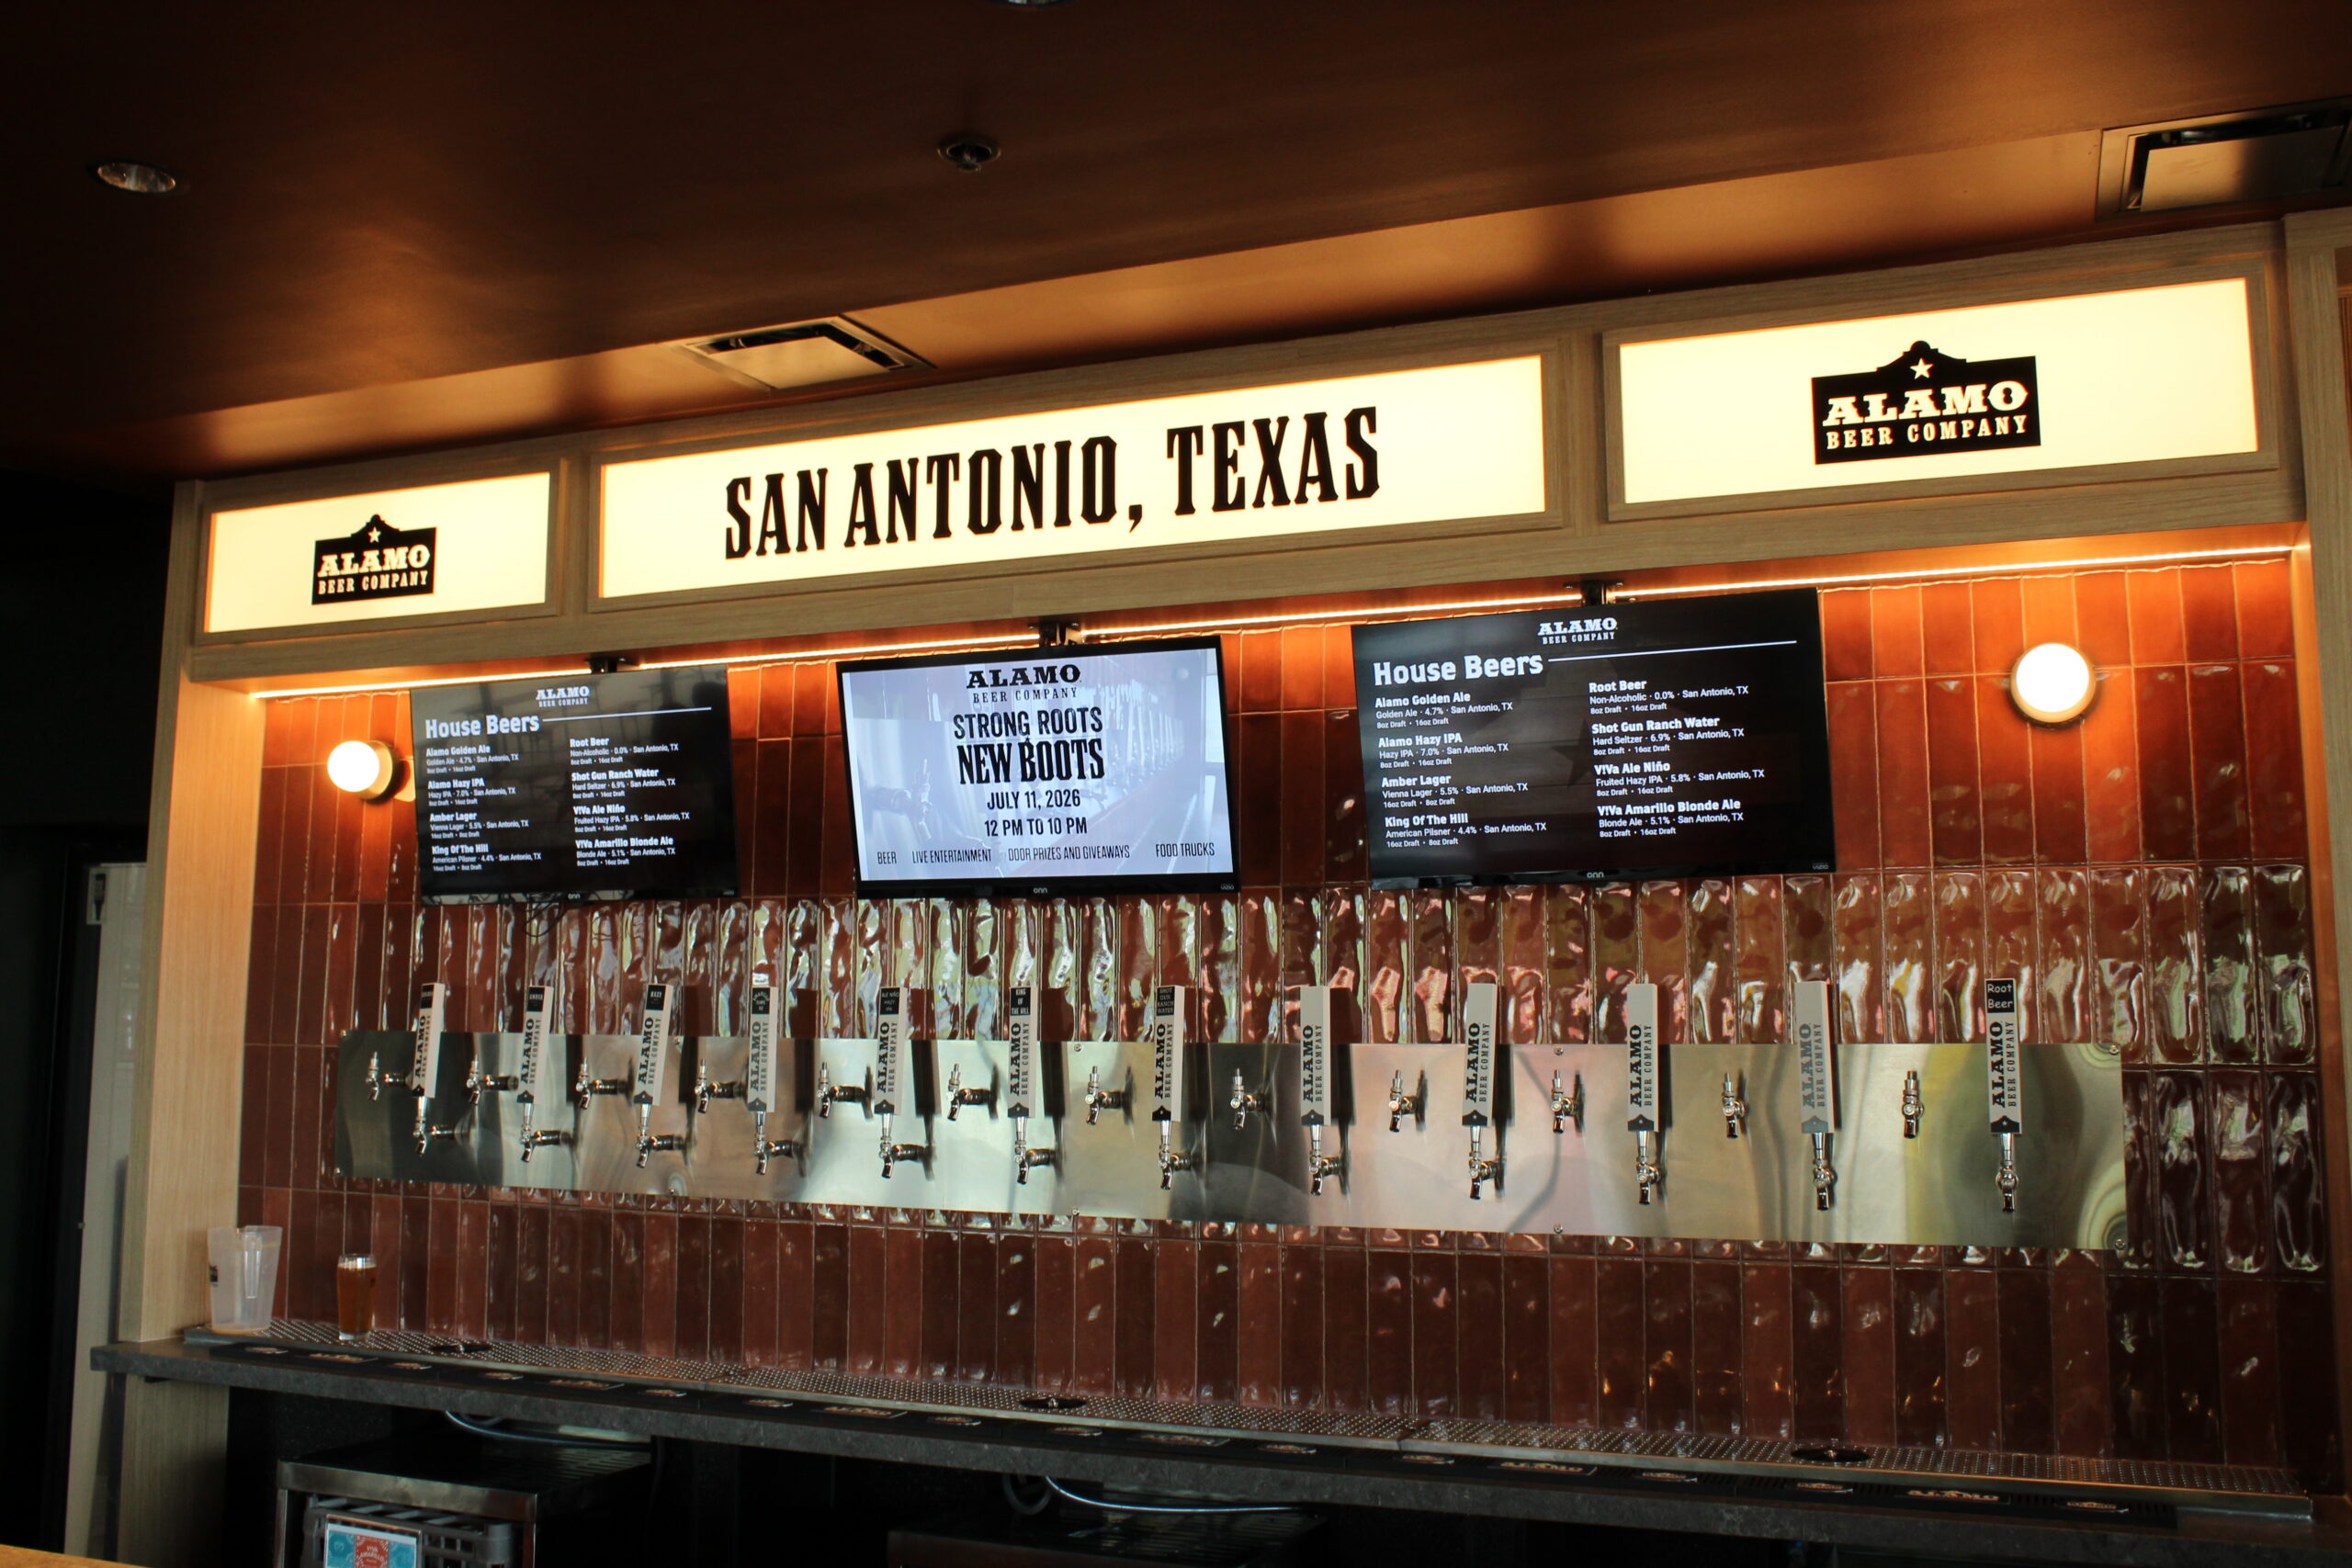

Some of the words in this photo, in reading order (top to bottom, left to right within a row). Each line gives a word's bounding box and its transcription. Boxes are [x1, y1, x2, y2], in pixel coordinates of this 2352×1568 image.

[1823, 380, 2029, 426] ALAMO
[1826, 427, 1893, 449] BEER
[1907, 415, 2027, 443] COMPANY
[726, 468, 828, 559] SAN
[844, 435, 1142, 547] ANTONIO,
[1167, 406, 1380, 516] TEXAS
[317, 544, 430, 577] ALAMO
[318, 578, 355, 595] BEER
[362, 570, 428, 591] COMPANY
[1538, 617, 1617, 636] ALAMO
[1543, 636, 1567, 645] BEER
[1571, 632, 1614, 643] COMPANY
[967, 664, 1080, 688] ALAMO
[1373, 660, 1456, 686] House
[1464, 654, 1544, 679] Beers
[536, 686, 590, 700] ALAMO
[973, 692, 1008, 704] BEER
[1015, 687, 1077, 701] COMPANY
[1589, 681, 1617, 694] Root
[1619, 680, 1647, 691] Beer
[1589, 693, 1647, 705] Non-Alcoholic
[1654, 691, 1675, 700] 0.0%
[1682, 689, 1699, 698] San
[1700, 686, 1735, 697] Antonio,
[1736, 685, 1748, 694] TX
[1374, 697, 1409, 708] Alamo
[1411, 694, 1450, 705] Golden
[1453, 691, 1470, 703] Ale
[1375, 709, 1404, 719] Golden
[1404, 708, 1418, 717] Ale
[1424, 706, 1443, 716] 4.7%
[1451, 705, 1466, 714] San
[1467, 703, 1500, 713] Antonio,
[1501, 701, 1513, 710] TX
[424, 718, 481, 739] House
[485, 715, 539, 735] Beers
[954, 711, 1030, 739] STRONG
[1038, 706, 1102, 735] ROOTS
[1376, 721, 1389, 729] 8oz
[1389, 719, 1407, 728] Draft
[1415, 718, 1431, 727] 16oz
[1431, 716, 1449, 726] Draft
[1591, 722, 1619, 734] Shot
[1620, 721, 1644, 732] Gun
[1645, 717, 1682, 730] Ranch
[1683, 716, 1720, 728] Water
[570, 738, 589, 748] Root
[590, 737, 609, 747] Beer
[1378, 737, 1413, 748] Alamo
[1415, 735, 1442, 747] Hazy
[1443, 732, 1463, 744] IPA
[425, 747, 449, 757] Alamo
[450, 745, 477, 755] Golden
[478, 744, 491, 753] Ale
[956, 742, 1012, 784] NEW
[1018, 739, 1105, 782] BOOTS
[1622, 762, 1641, 773] Ale
[1643, 761, 1670, 773] Niño
[427, 780, 451, 789] Alamo
[452, 779, 470, 789] Hazy
[471, 777, 484, 787] IPA
[571, 772, 590, 782] Shot
[591, 771, 606, 781] Gun
[608, 769, 633, 780] Ranch
[634, 768, 659, 778] Water
[1381, 776, 1418, 787] Amber
[1419, 774, 1452, 787] Lager
[1595, 776, 1624, 787] Fruited
[1625, 776, 1646, 786] Hazy
[1648, 774, 1663, 784] IPA
[1670, 773, 1690, 783] 5.8%
[1698, 772, 1714, 781] San
[1715, 770, 1751, 780] Antonio,
[1752, 769, 1764, 778] TX
[592, 805, 605, 814] Ale
[606, 803, 625, 814] Niño
[987, 792, 1021, 810] JULY
[1025, 791, 1042, 811] 11,
[1046, 789, 1080, 807] 2026
[1624, 802, 1675, 815] Amarillo
[1677, 799, 1719, 812] Blonde
[1721, 798, 1740, 810] Ale
[429, 812, 454, 822] Amber
[455, 811, 477, 822] Lager
[1385, 816, 1409, 829] King
[1412, 815, 1425, 826] Of
[1426, 814, 1447, 825] The
[1449, 812, 1468, 824] Hill
[984, 820, 999, 837] 12
[1002, 819, 1023, 836] PM
[1027, 818, 1044, 836] TO
[1048, 818, 1063, 835] 10
[1067, 818, 1088, 835] PM
[1613, 829, 1631, 837] Draft
[1640, 828, 1657, 836] 16oz
[1658, 826, 1676, 835] Draft
[431, 845, 448, 855] King
[450, 844, 459, 854] Of
[459, 844, 474, 853] The
[475, 843, 488, 853] Hill
[594, 838, 628, 848] Amarillo
[629, 836, 659, 847] Blonde
[660, 836, 673, 845] Ale
[1156, 844, 1178, 858] FOOD
[1181, 842, 1215, 857] TRUCKS
[877, 852, 897, 864] BEER
[912, 850, 928, 863] LIVE
[930, 849, 991, 863] ENTERTAINMENT
[1008, 848, 1031, 862] DOOR
[1033, 847, 1061, 861] PRIZES
[1063, 846, 1080, 860] AND
[1082, 844, 1130, 859] GIVEAWAYS
[1033, 886, 1048, 895] onn
[1987, 983, 2013, 994] Root
[1987, 998, 2013, 1009] Beer
[1481, 1023, 1490, 1070] COMPANY
[2005, 1021, 2015, 1072] COMPANY
[876, 1021, 889, 1093] ALAMO
[1010, 1022, 1022, 1096] ALAMO
[1154, 1023, 1166, 1099] ALAMO
[1303, 1025, 1314, 1102] ALAMO
[1466, 1022, 1480, 1102] ALAMO
[1630, 1025, 1642, 1107] ALAMO
[1989, 1021, 2005, 1108] ALAMO
[1479, 1076, 1487, 1102] BEER
[2007, 1078, 2016, 1106] BEER
